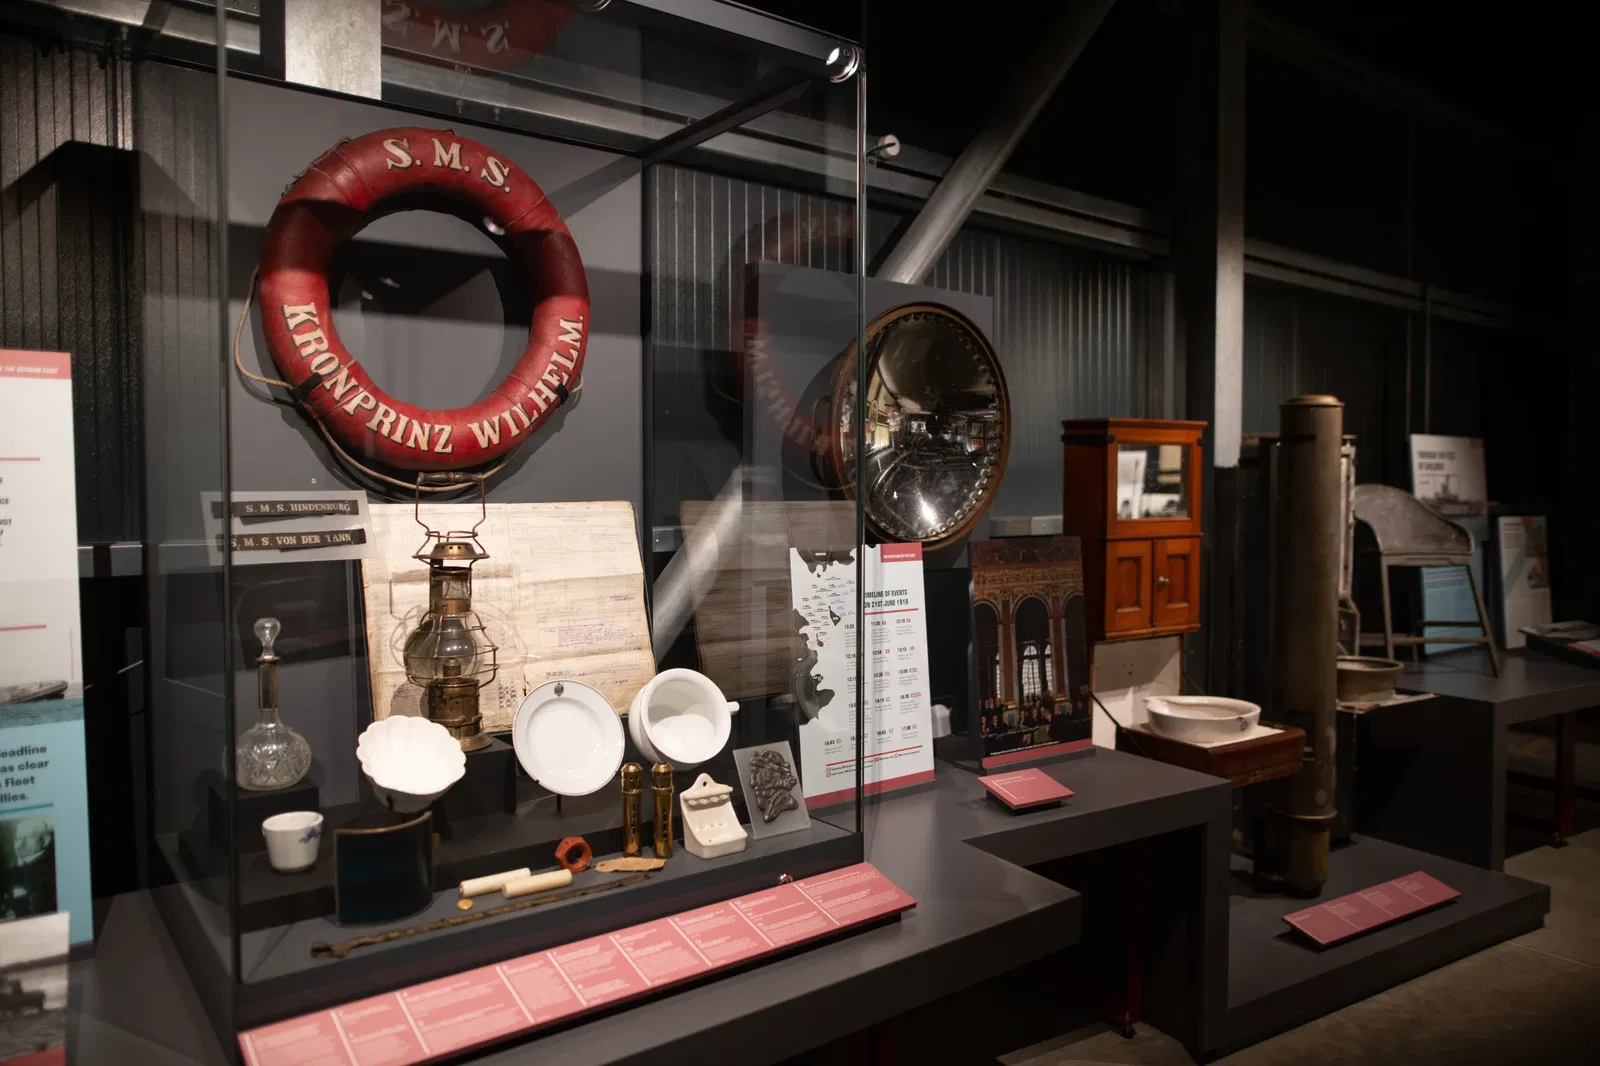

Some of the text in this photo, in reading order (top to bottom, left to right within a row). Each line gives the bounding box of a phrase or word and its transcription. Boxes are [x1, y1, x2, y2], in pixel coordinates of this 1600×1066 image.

[283, 301, 455, 456] KRONPRINZ
[466, 313, 585, 449] WILHELM.
[290, 503, 351, 512] HINDENBURG
[275, 536, 297, 545] VON
[301, 535, 321, 544] DER
[325, 533, 352, 543] TANN
[891, 589, 908, 597] EVENTS
[871, 600, 883, 608] 21ST
[883, 599, 896, 607] JUNE
[896, 598, 909, 606] 1919
[18, 760, 50, 771] clear
[5, 776, 36, 788] Fleet
